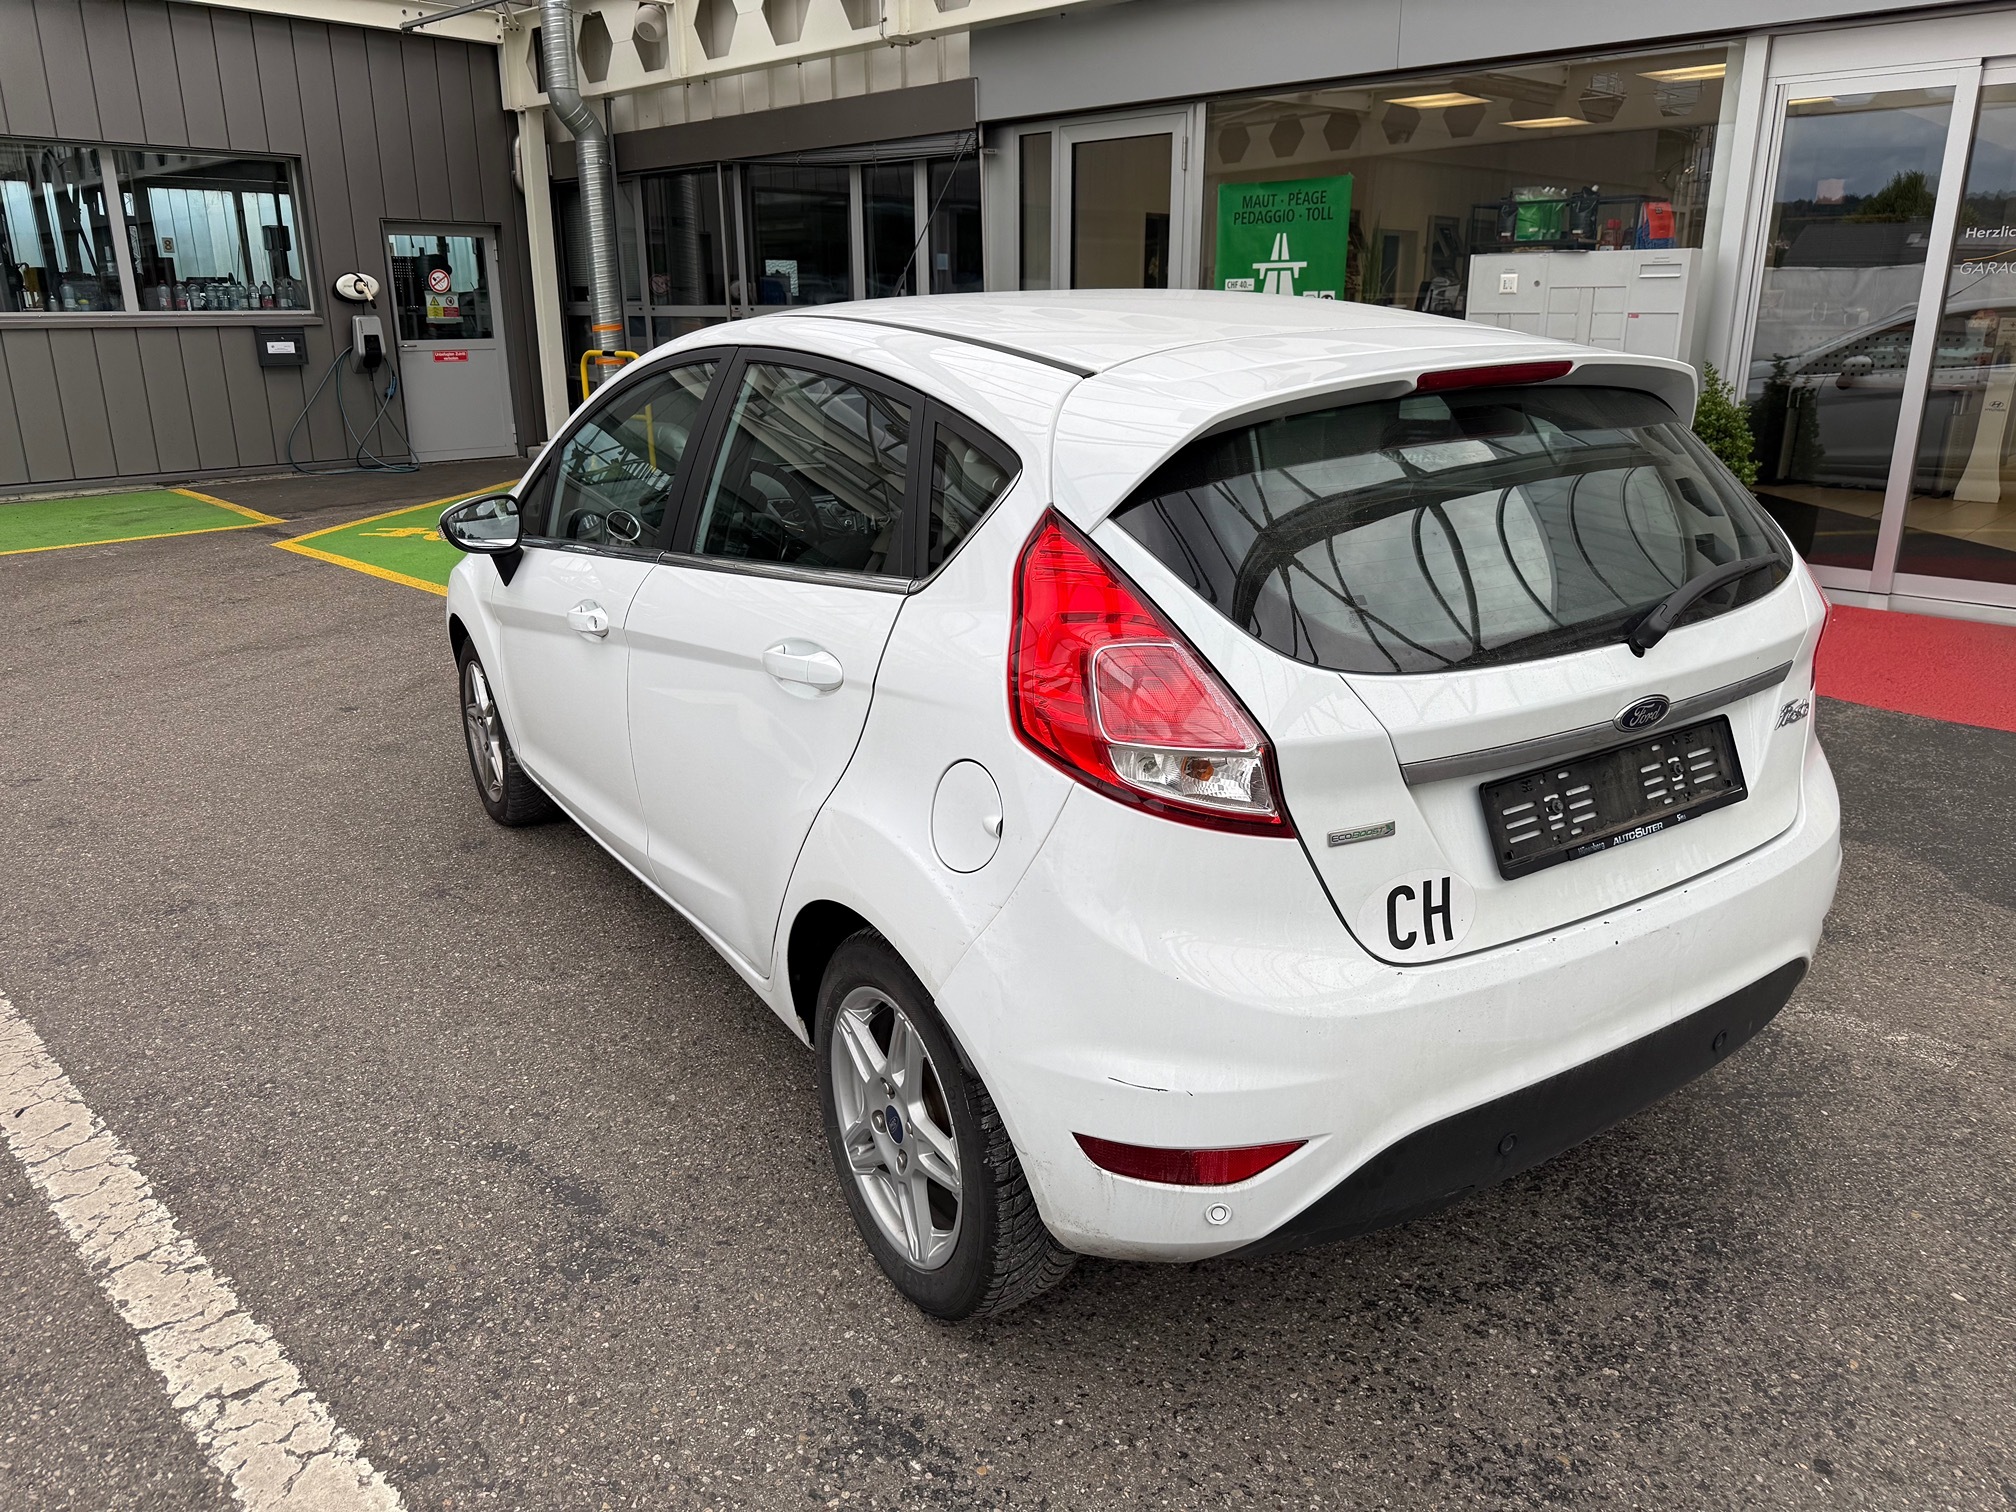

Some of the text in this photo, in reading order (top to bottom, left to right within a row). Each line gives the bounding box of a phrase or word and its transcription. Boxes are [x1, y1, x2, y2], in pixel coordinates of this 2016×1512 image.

[1242, 189, 1327, 208] MAUT PÉAGE
[1233, 206, 1333, 225] PEDAGGIO TOLL
[164, 239, 172, 250] 8
[1226, 280, 1238, 289] CHF
[1629, 703, 1662, 727] Ford
[1331, 825, 1386, 843] ECOBOOST
[1386, 876, 1454, 950] CH
